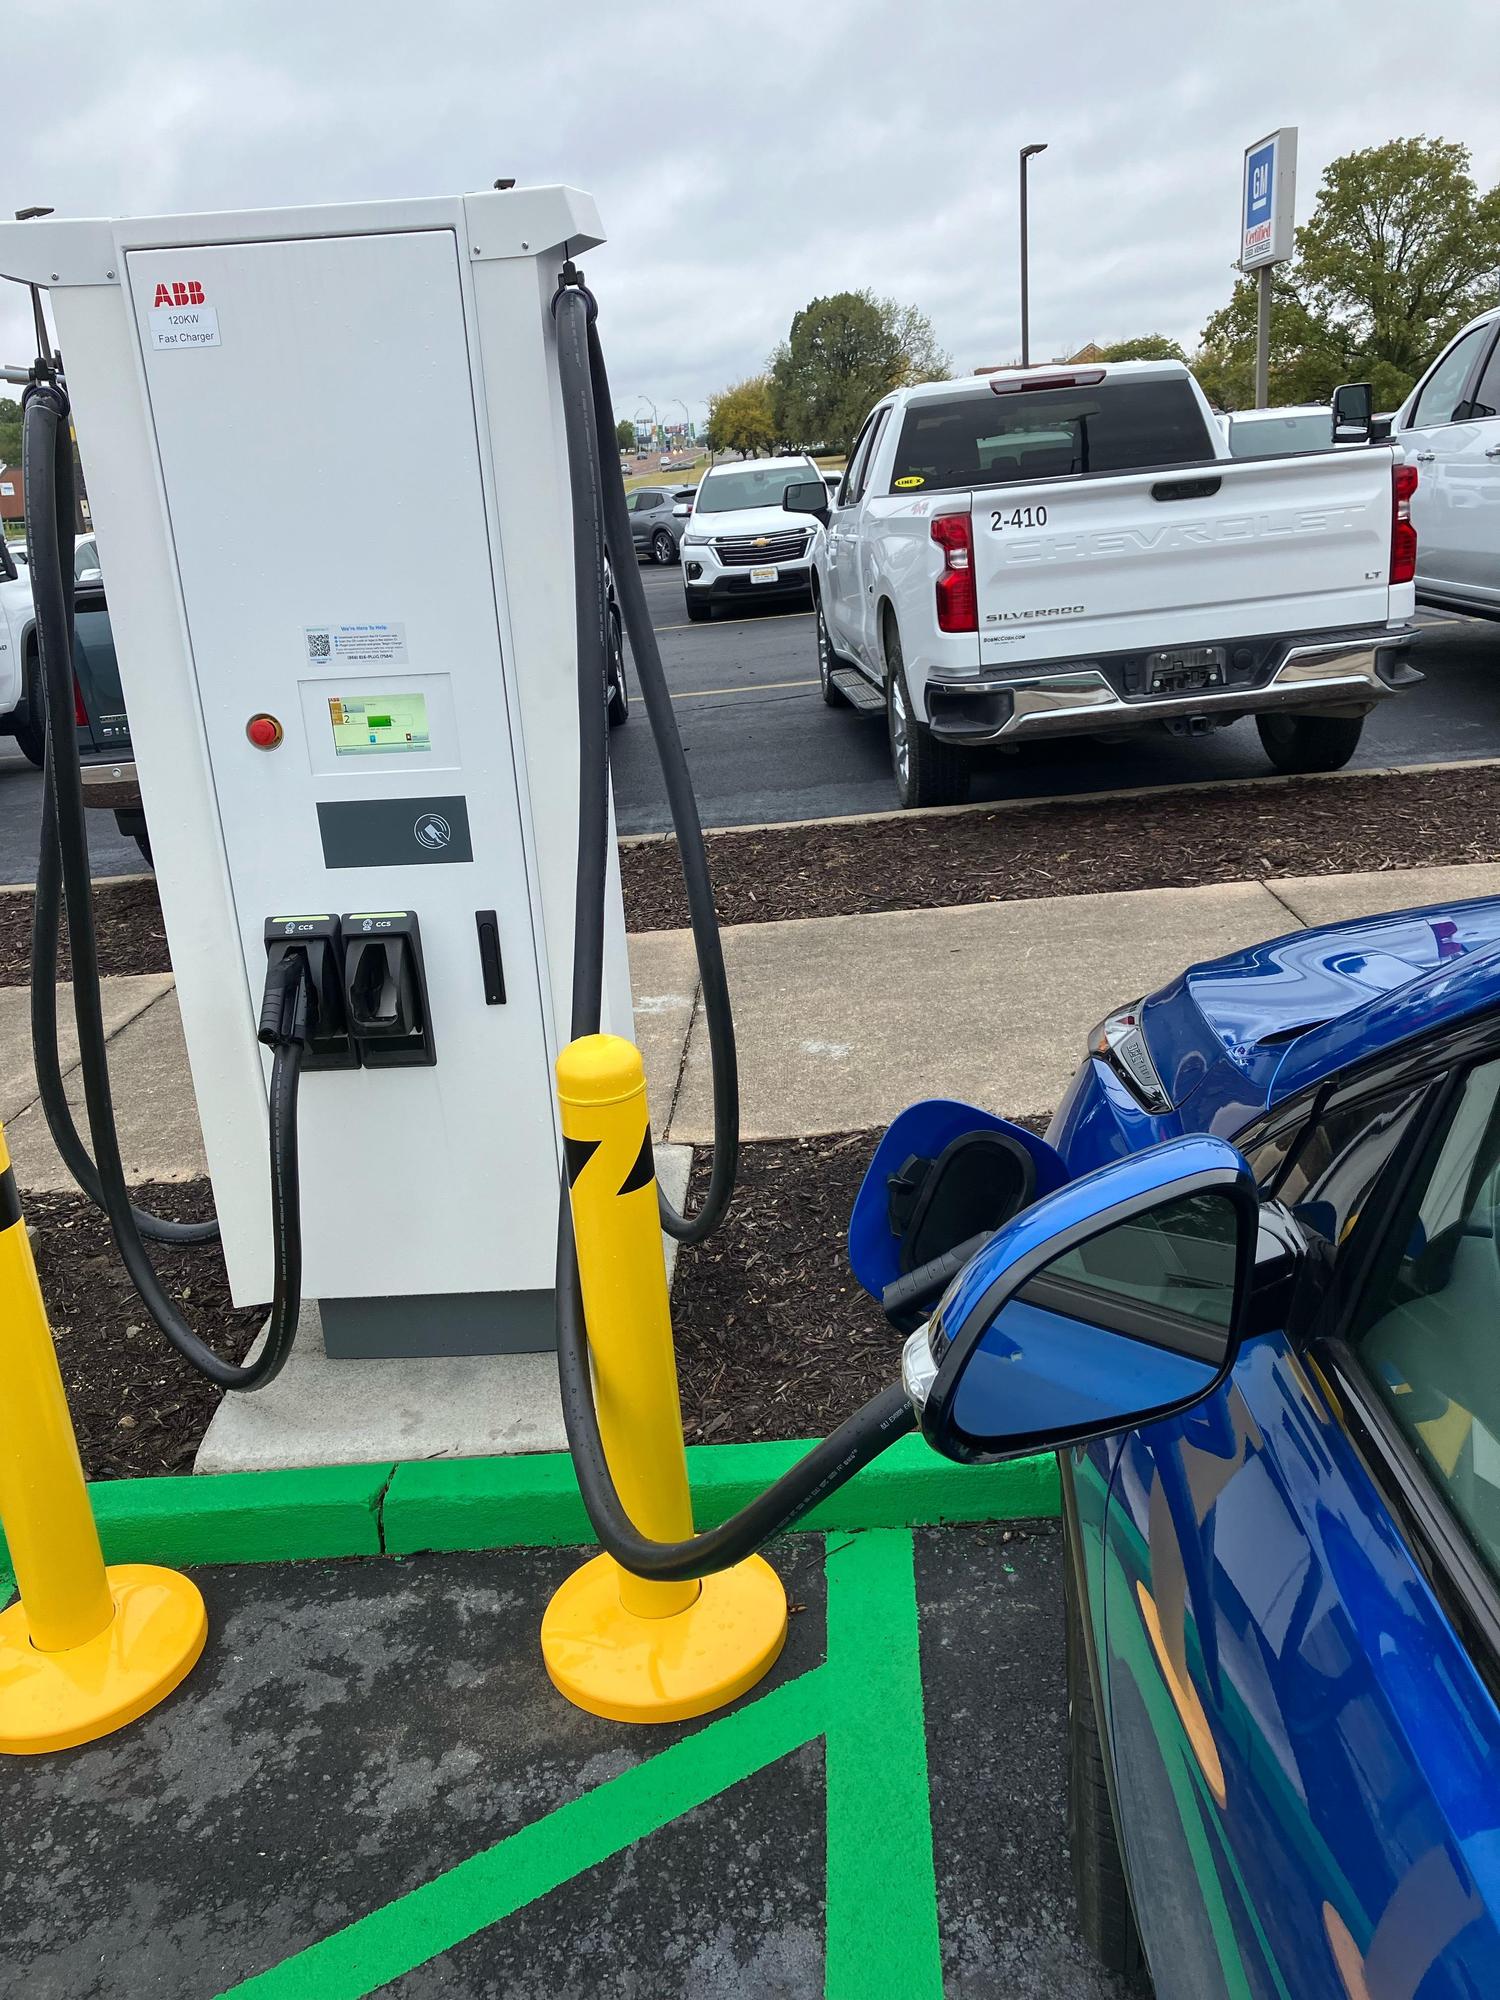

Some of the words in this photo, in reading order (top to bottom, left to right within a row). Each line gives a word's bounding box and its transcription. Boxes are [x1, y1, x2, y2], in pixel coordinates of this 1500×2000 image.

[1253, 163, 1268, 199] GM
[1246, 222, 1271, 246] Certified
[154, 281, 205, 307] ABB
[168, 315, 199, 325] 120KW
[158, 333, 178, 343] Fast
[179, 332, 214, 343] Charger
[990, 506, 1047, 531] 2-410
[1006, 505, 1366, 564] CHEVROLET
[1364, 571, 1382, 580] LT
[986, 605, 1085, 622] SILVERADO
[344, 715, 350, 723] 2
